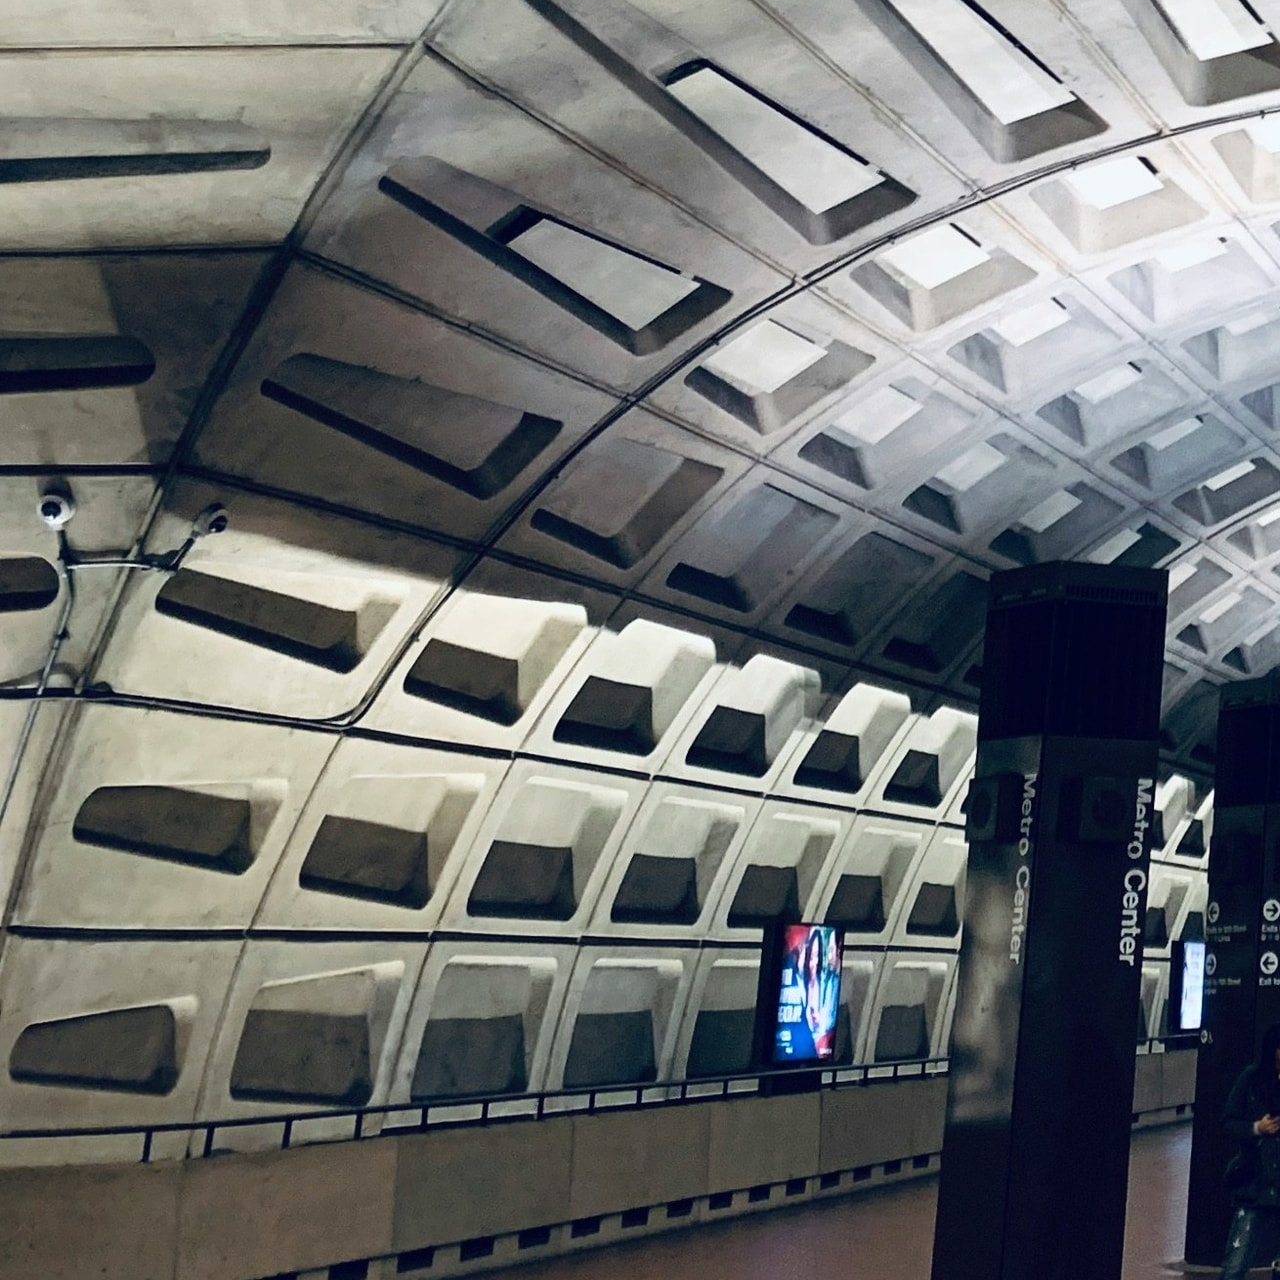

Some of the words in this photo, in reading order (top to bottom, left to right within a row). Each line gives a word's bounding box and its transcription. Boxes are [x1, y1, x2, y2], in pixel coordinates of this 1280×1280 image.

[1019, 773, 1038, 856] Metro
[1127, 778, 1154, 859] Metro
[1009, 865, 1030, 965] Center
[1118, 868, 1147, 967] Center
